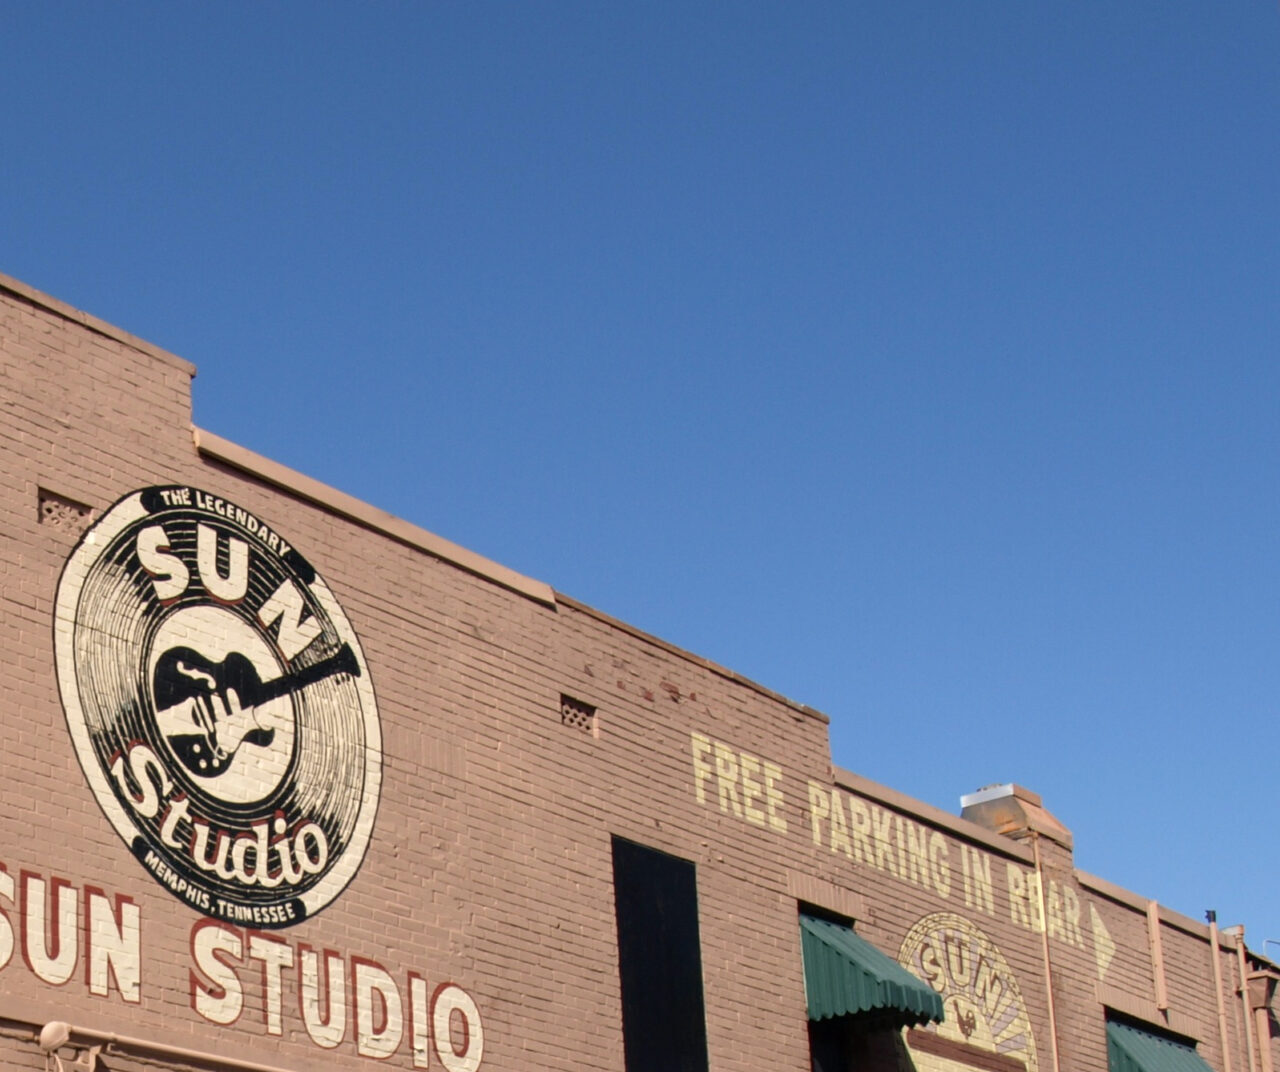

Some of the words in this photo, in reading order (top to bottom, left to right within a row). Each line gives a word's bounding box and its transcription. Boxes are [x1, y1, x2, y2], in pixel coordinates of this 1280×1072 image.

[160, 488, 192, 506] THE
[196, 491, 291, 557] LEGENDARY
[136, 522, 323, 662] SUN
[109, 741, 329, 888] Studio
[690, 732, 789, 834] FREE
[808, 780, 951, 899] PARKING
[960, 843, 996, 917] IN
[1006, 862, 1087, 950] REAR
[217, 900, 296, 923] TENNESSEE
[920, 934, 1004, 1018] SUN
